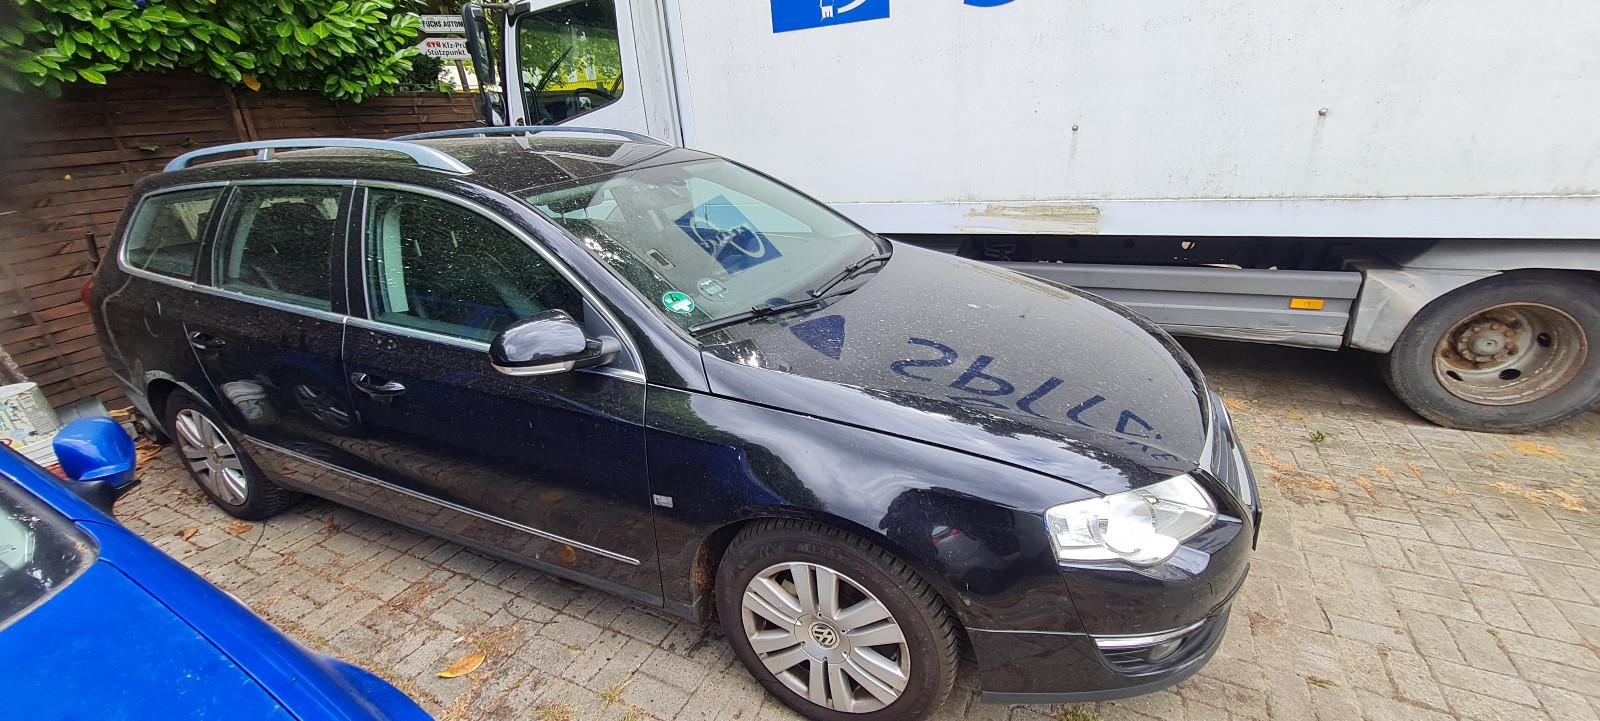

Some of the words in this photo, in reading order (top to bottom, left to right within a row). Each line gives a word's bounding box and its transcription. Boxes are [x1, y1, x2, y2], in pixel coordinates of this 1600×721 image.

[422, 20, 442, 28] FUCHS
[443, 20, 465, 28] AUTOM
[442, 41, 466, 49] Kfz-Prü
[427, 49, 466, 57] Stützpunkt
